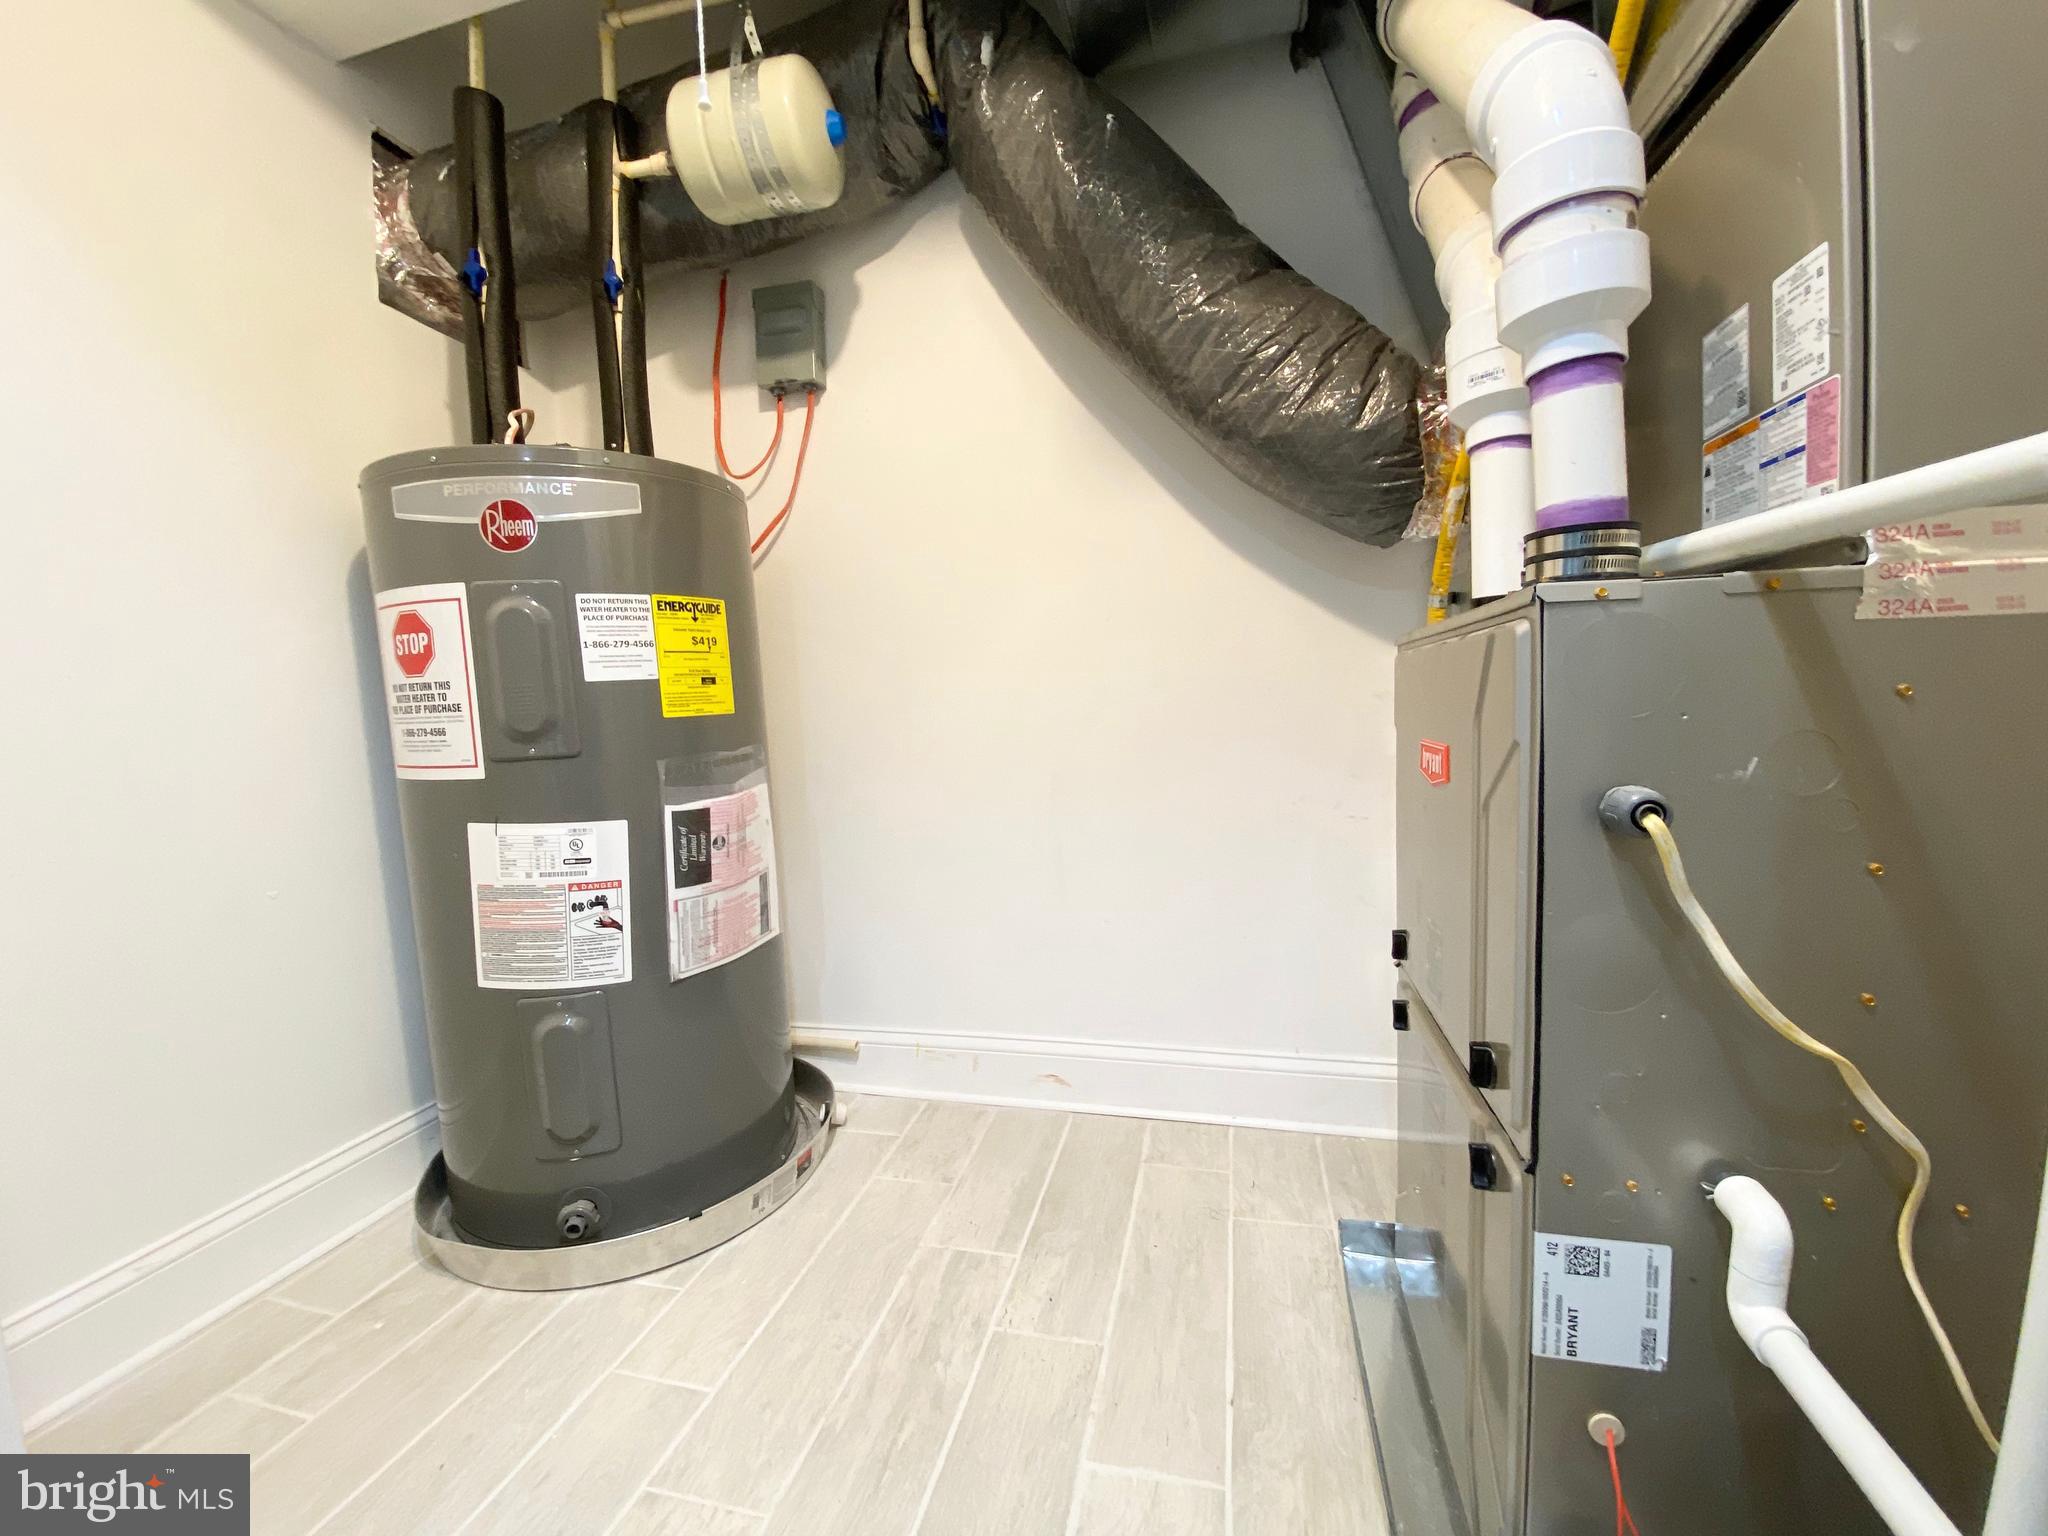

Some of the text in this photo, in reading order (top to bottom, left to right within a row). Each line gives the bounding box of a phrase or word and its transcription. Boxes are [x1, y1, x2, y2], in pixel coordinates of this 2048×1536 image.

[443, 482, 573, 497] PERFORMANCE
[485, 501, 534, 544] Rheem
[1875, 524, 1930, 543] 324A
[1880, 560, 1934, 580] 324A
[1878, 598, 1934, 616] 324A
[396, 632, 428, 655] STOP
[583, 640, 655, 649] 1-866-279-4566
[409, 682, 432, 692] RETURN
[434, 681, 451, 690] THIS
[412, 693, 436, 703] HEATER
[438, 692, 447, 702] TO
[424, 703, 462, 713] PURCHASE
[581, 881, 619, 890] DANGER
[1547, 1242, 1559, 1256] 412
[1567, 1307, 1578, 1357] BRYANT
